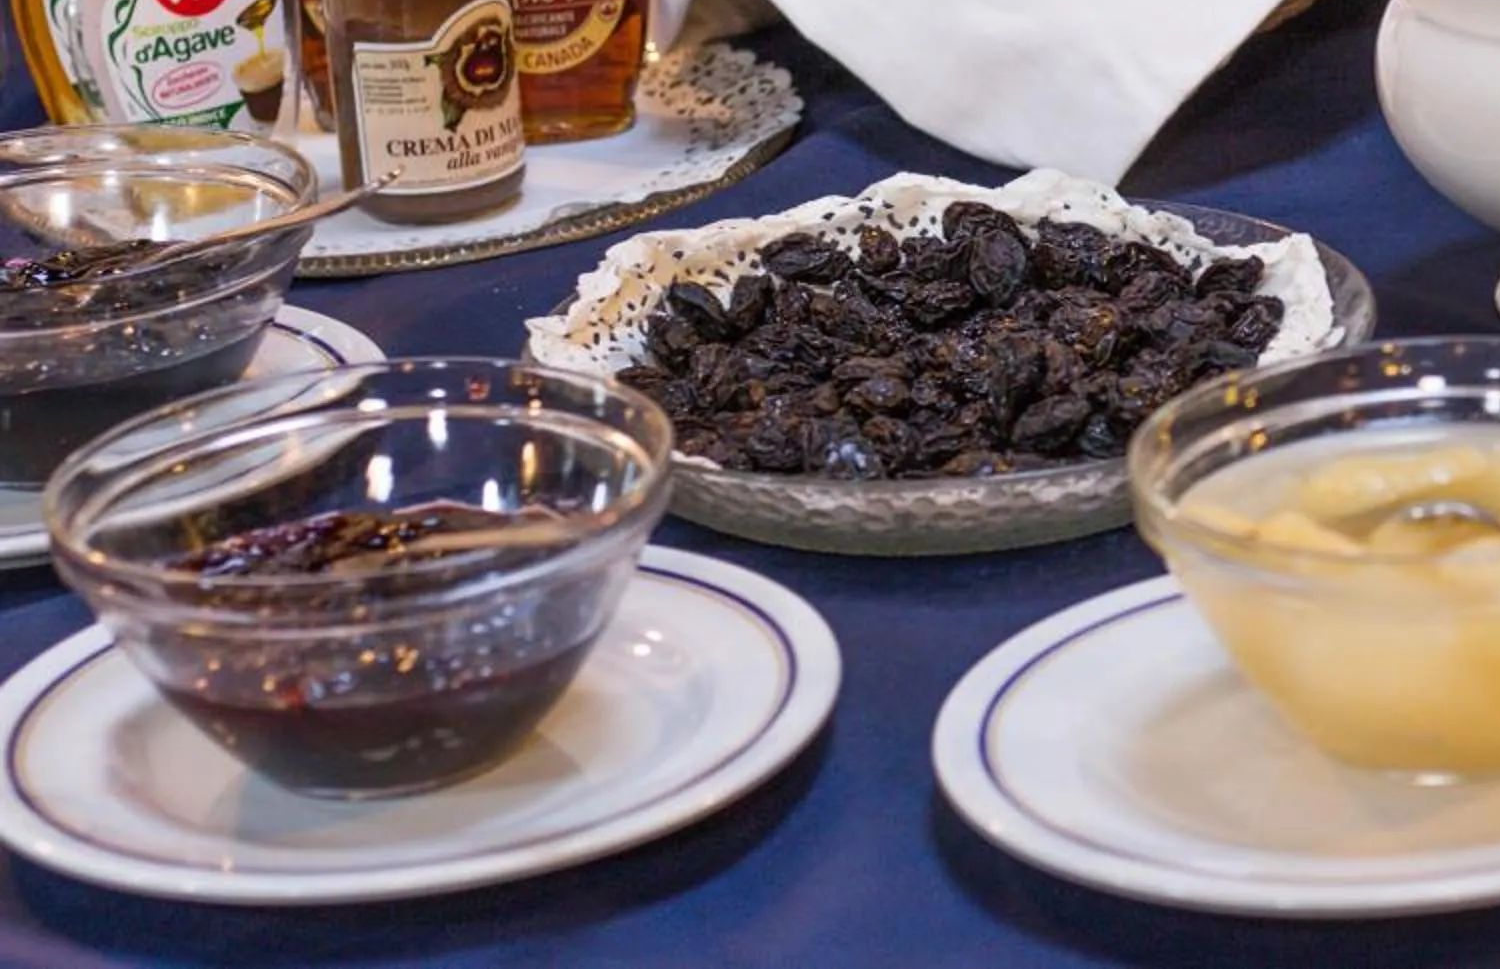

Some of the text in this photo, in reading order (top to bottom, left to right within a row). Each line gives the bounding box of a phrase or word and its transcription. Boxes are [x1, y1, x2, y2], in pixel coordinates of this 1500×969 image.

[135, 26, 236, 63] d'Agave
[523, 35, 594, 69] CANADA
[386, 133, 470, 158] CREMA
[474, 126, 496, 147] DI
[446, 148, 481, 171] alla
